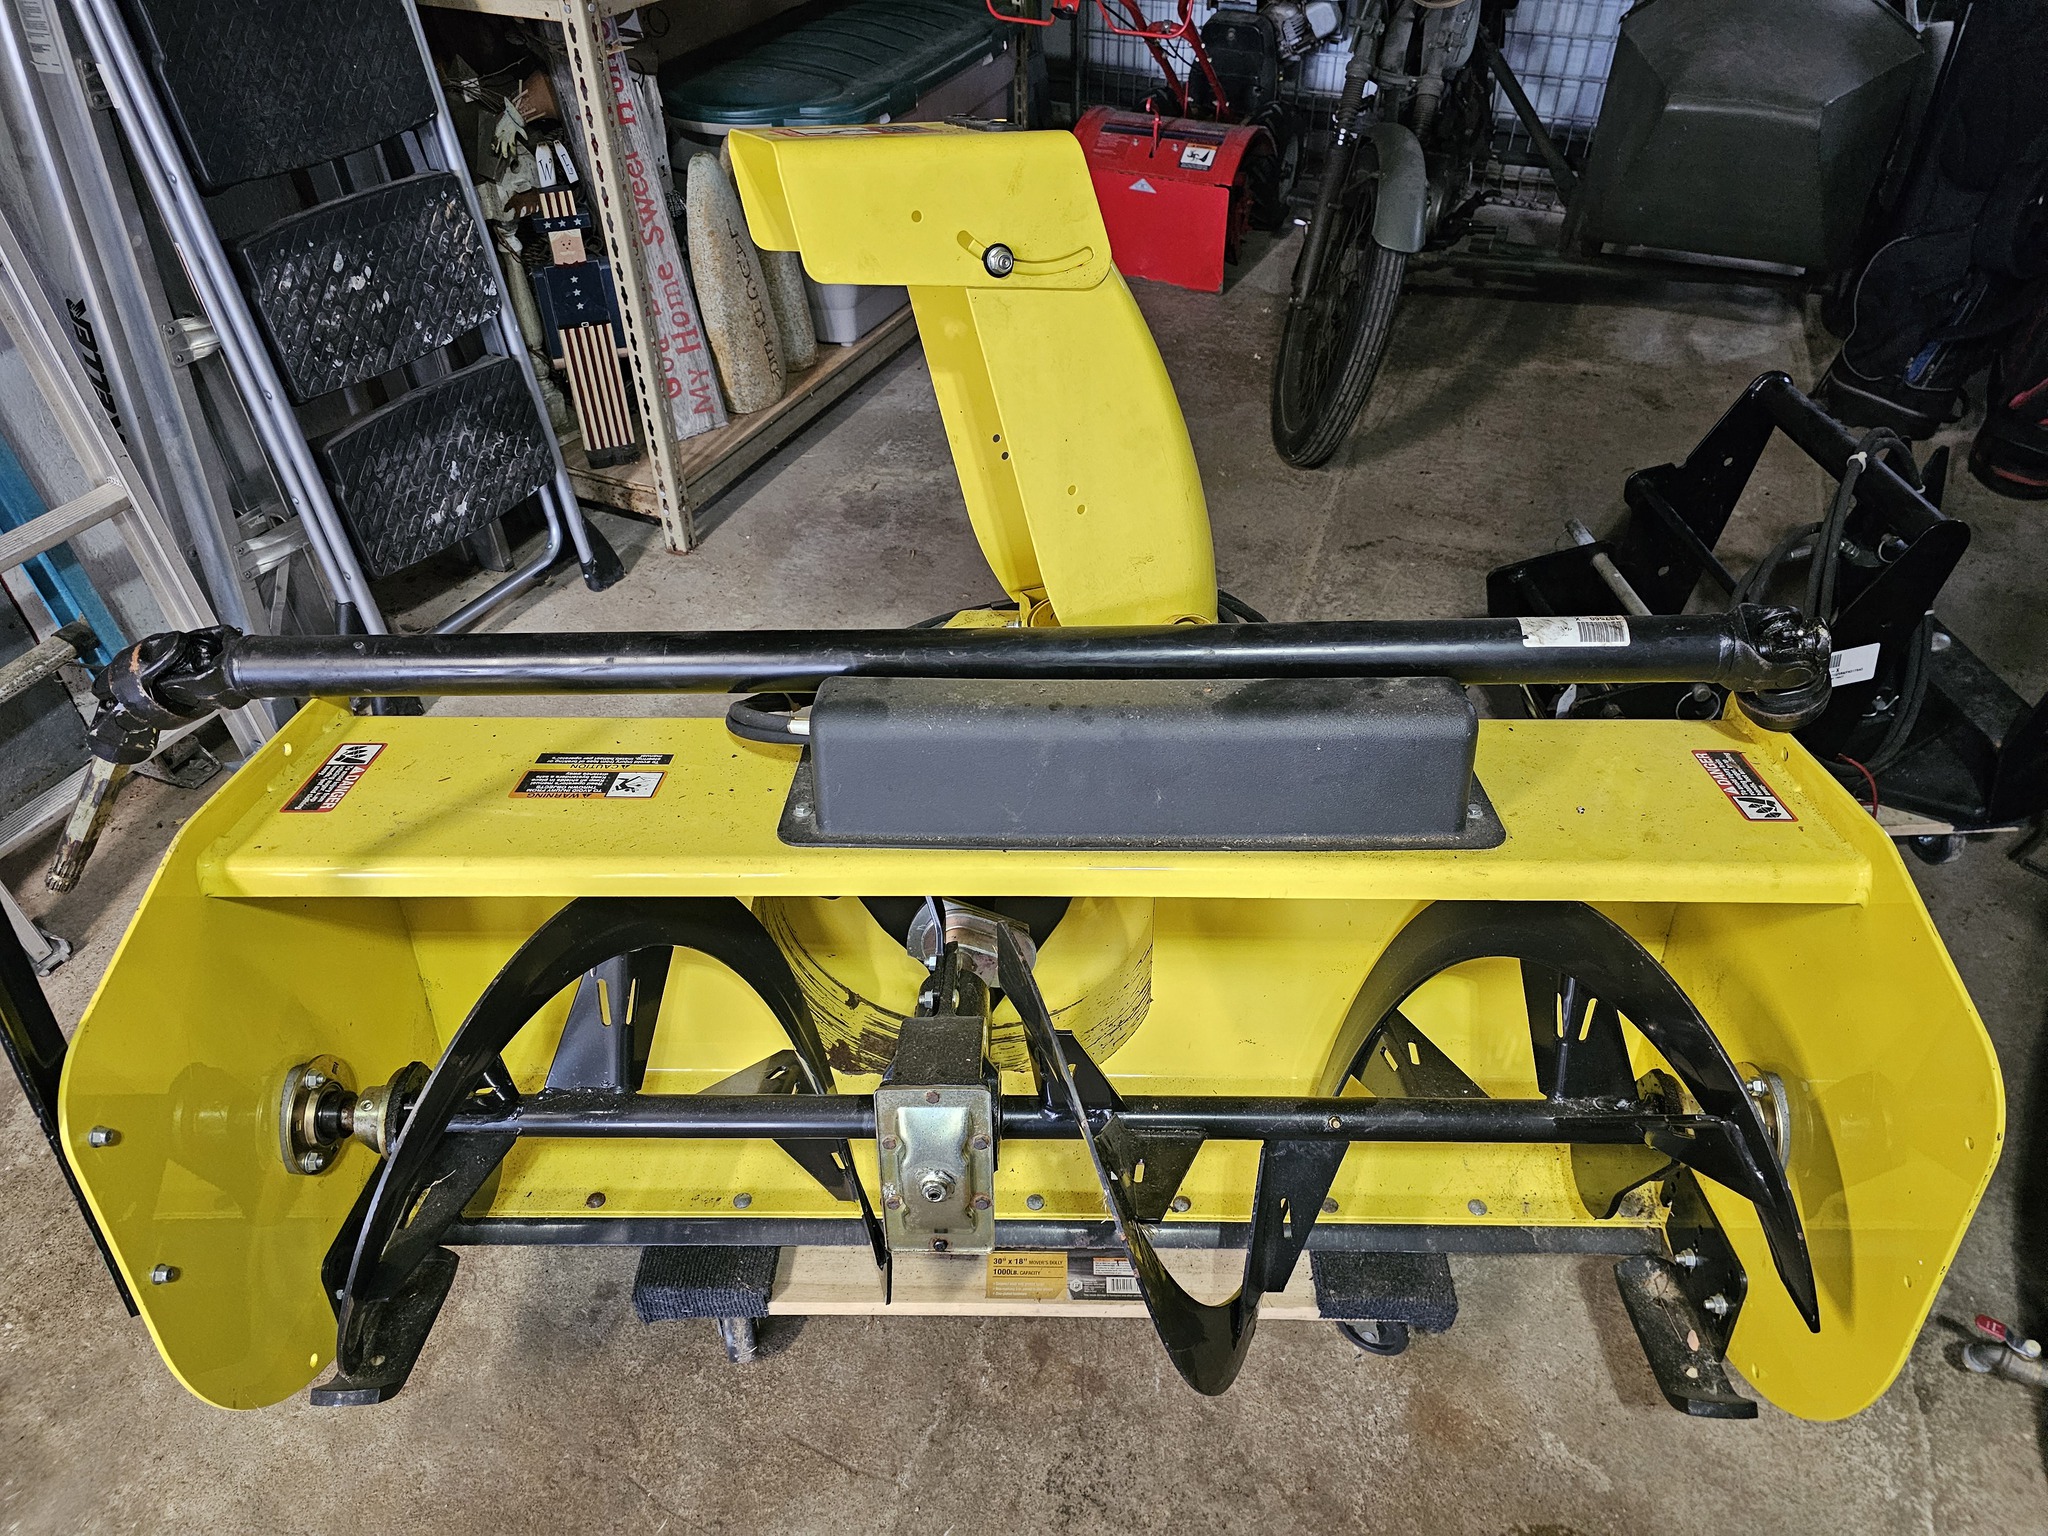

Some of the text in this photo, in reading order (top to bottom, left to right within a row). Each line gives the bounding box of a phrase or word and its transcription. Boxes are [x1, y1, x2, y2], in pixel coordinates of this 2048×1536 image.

[657, 260, 701, 355] Home
[725, 218, 782, 386] LAUGHTER
[66, 298, 127, 445] ELLER
[320, 774, 361, 809] DANGER
[1695, 753, 1732, 785] DANGER
[993, 1257, 1007, 1265] 30"
[1013, 1257, 1028, 1265] 18"
